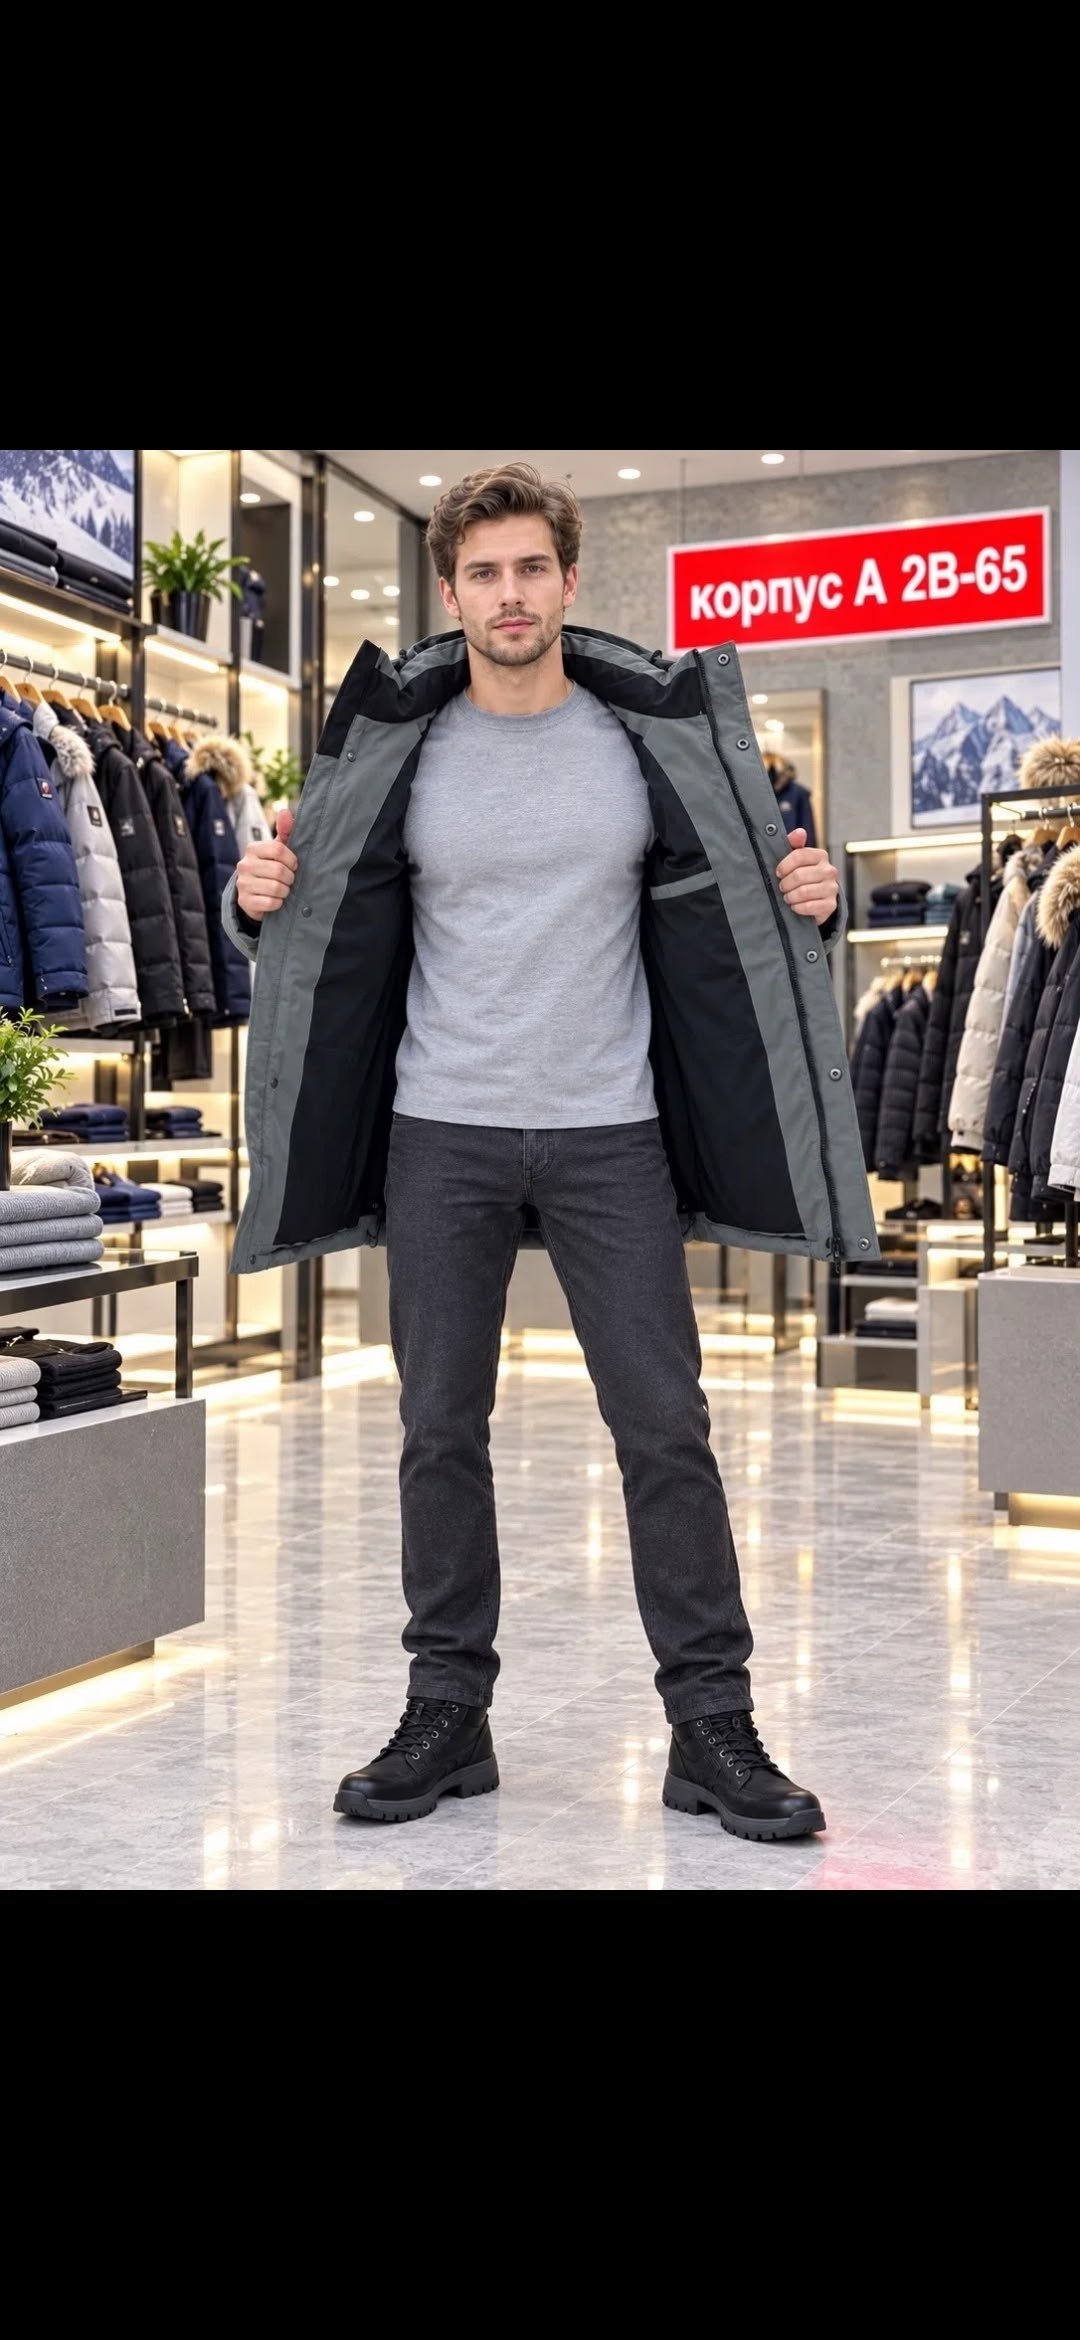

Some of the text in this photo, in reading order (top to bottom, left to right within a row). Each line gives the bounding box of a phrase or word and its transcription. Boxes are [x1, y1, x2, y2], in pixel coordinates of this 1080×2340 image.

[691, 544, 1028, 627] корпус А 2В-65
